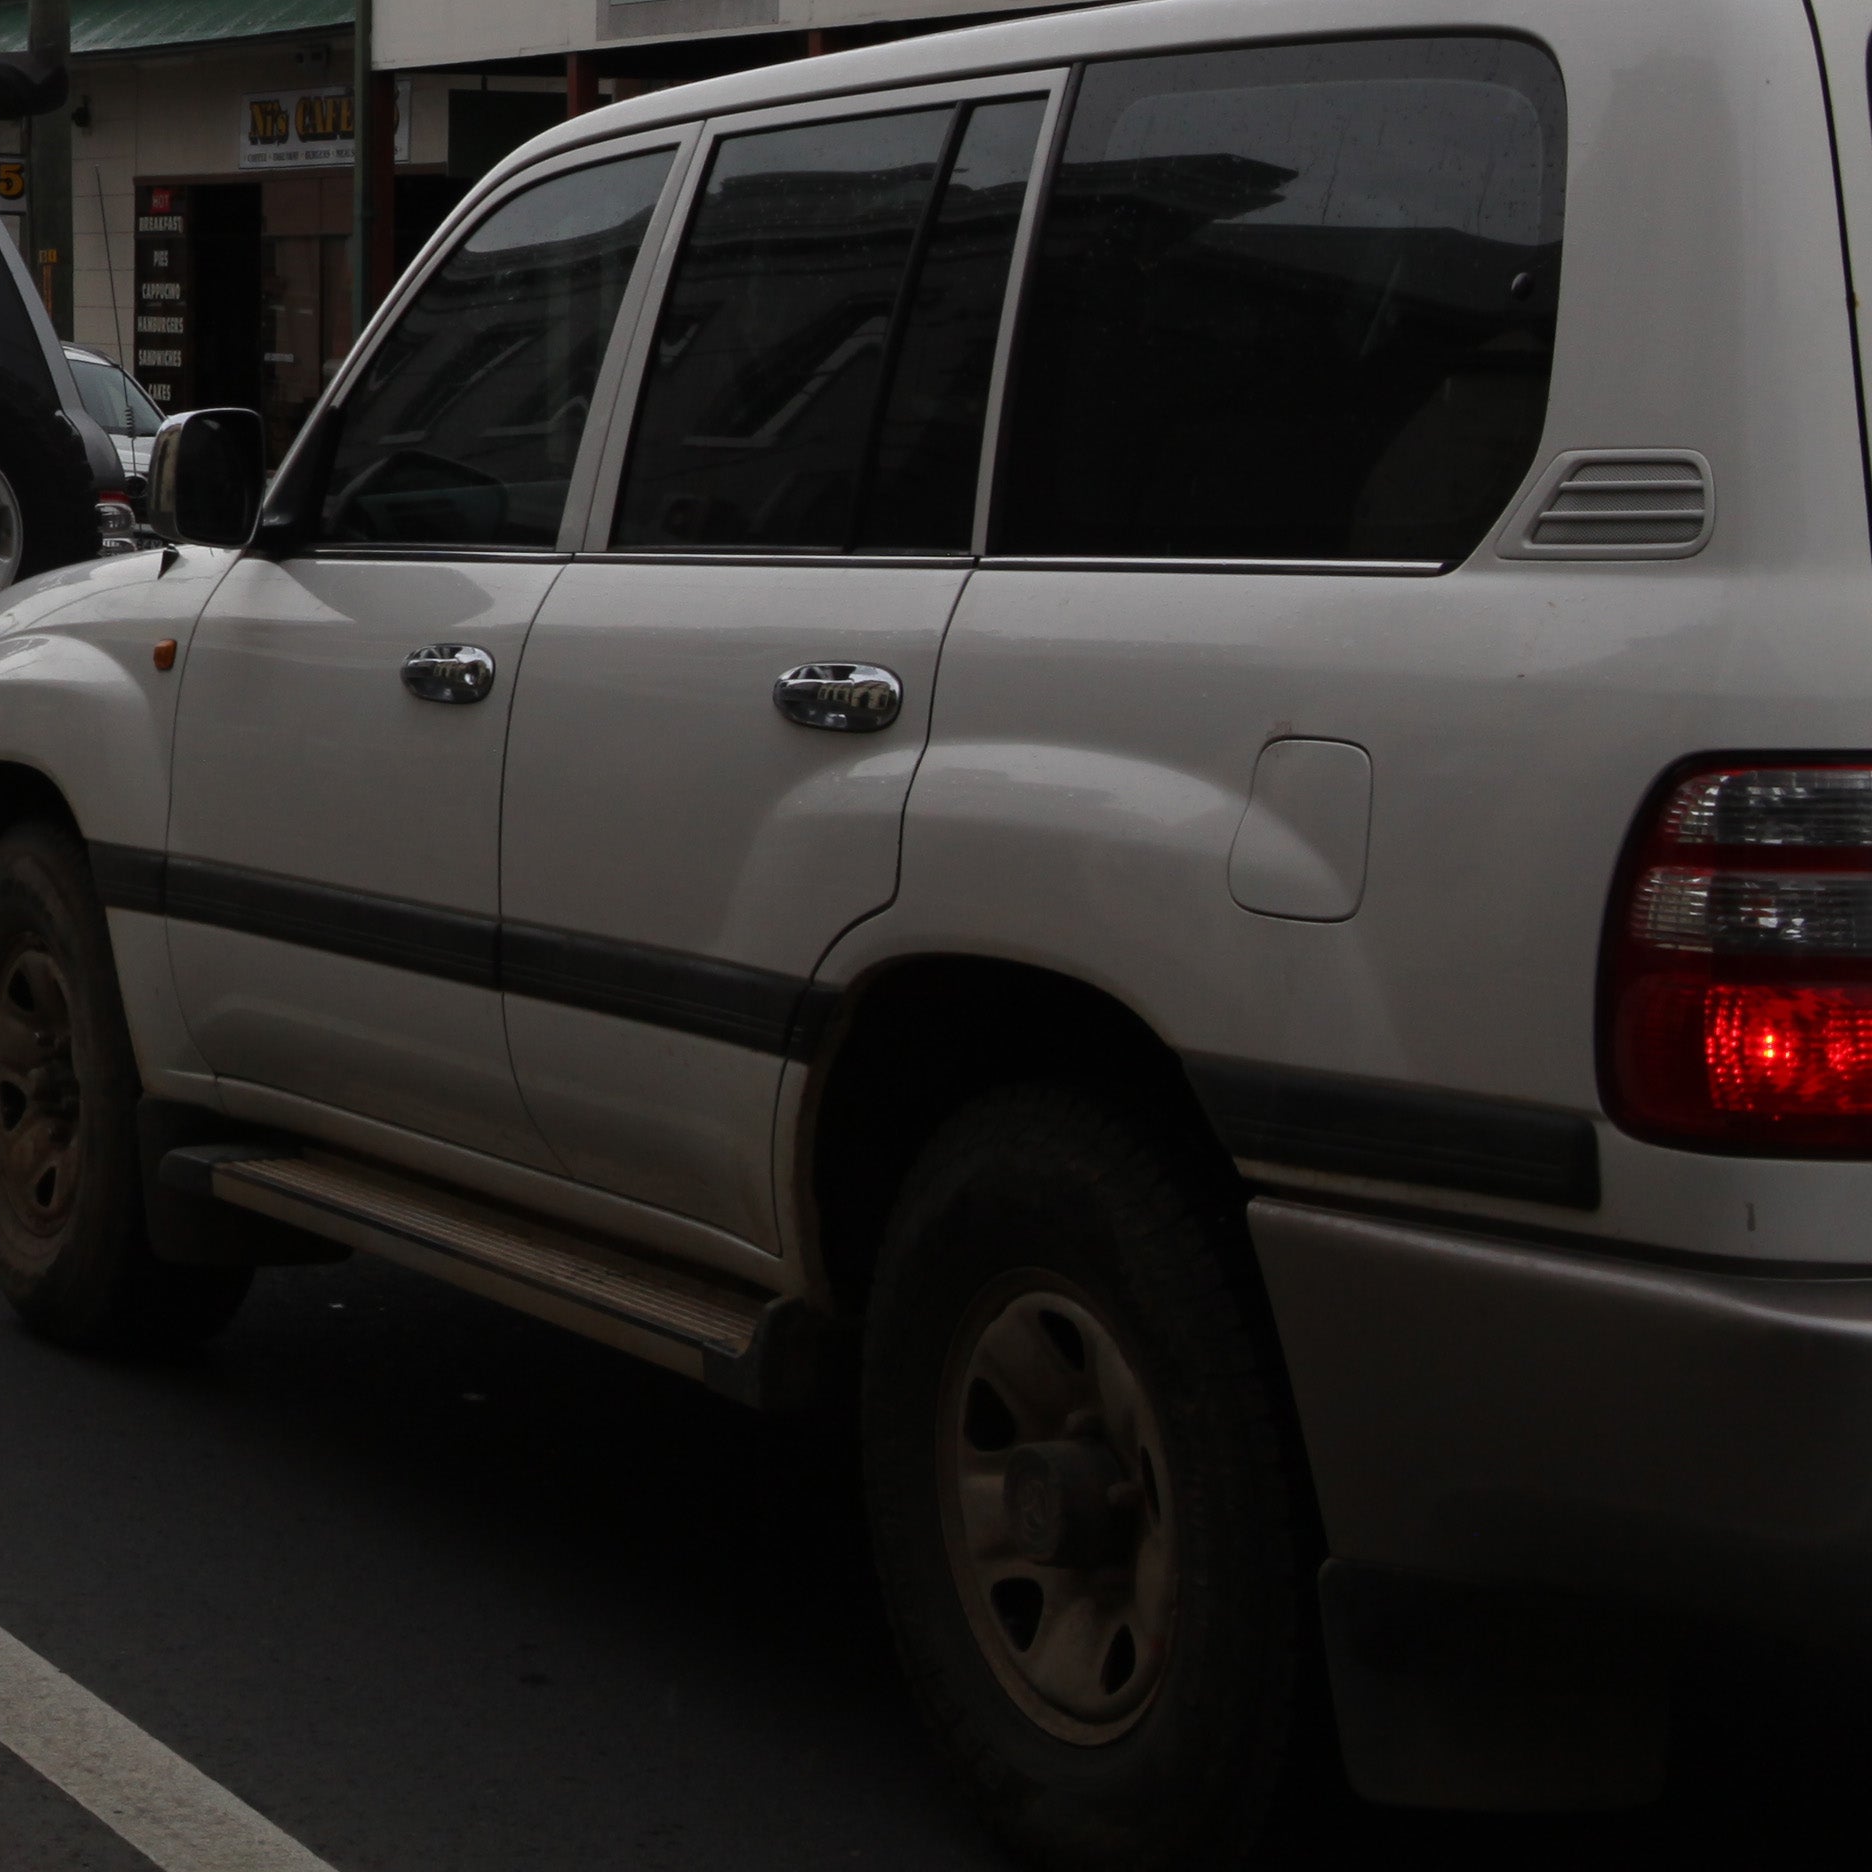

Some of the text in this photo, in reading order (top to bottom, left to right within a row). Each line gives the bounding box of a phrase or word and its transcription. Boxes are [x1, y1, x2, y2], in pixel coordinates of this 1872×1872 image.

[152, 193, 170, 209] HOT
[139, 215, 184, 233] BREAKFAST
[153, 248, 169, 267] PIES
[137, 315, 184, 334] HAMBURGERS
[138, 349, 182, 367] SANDWICHES
